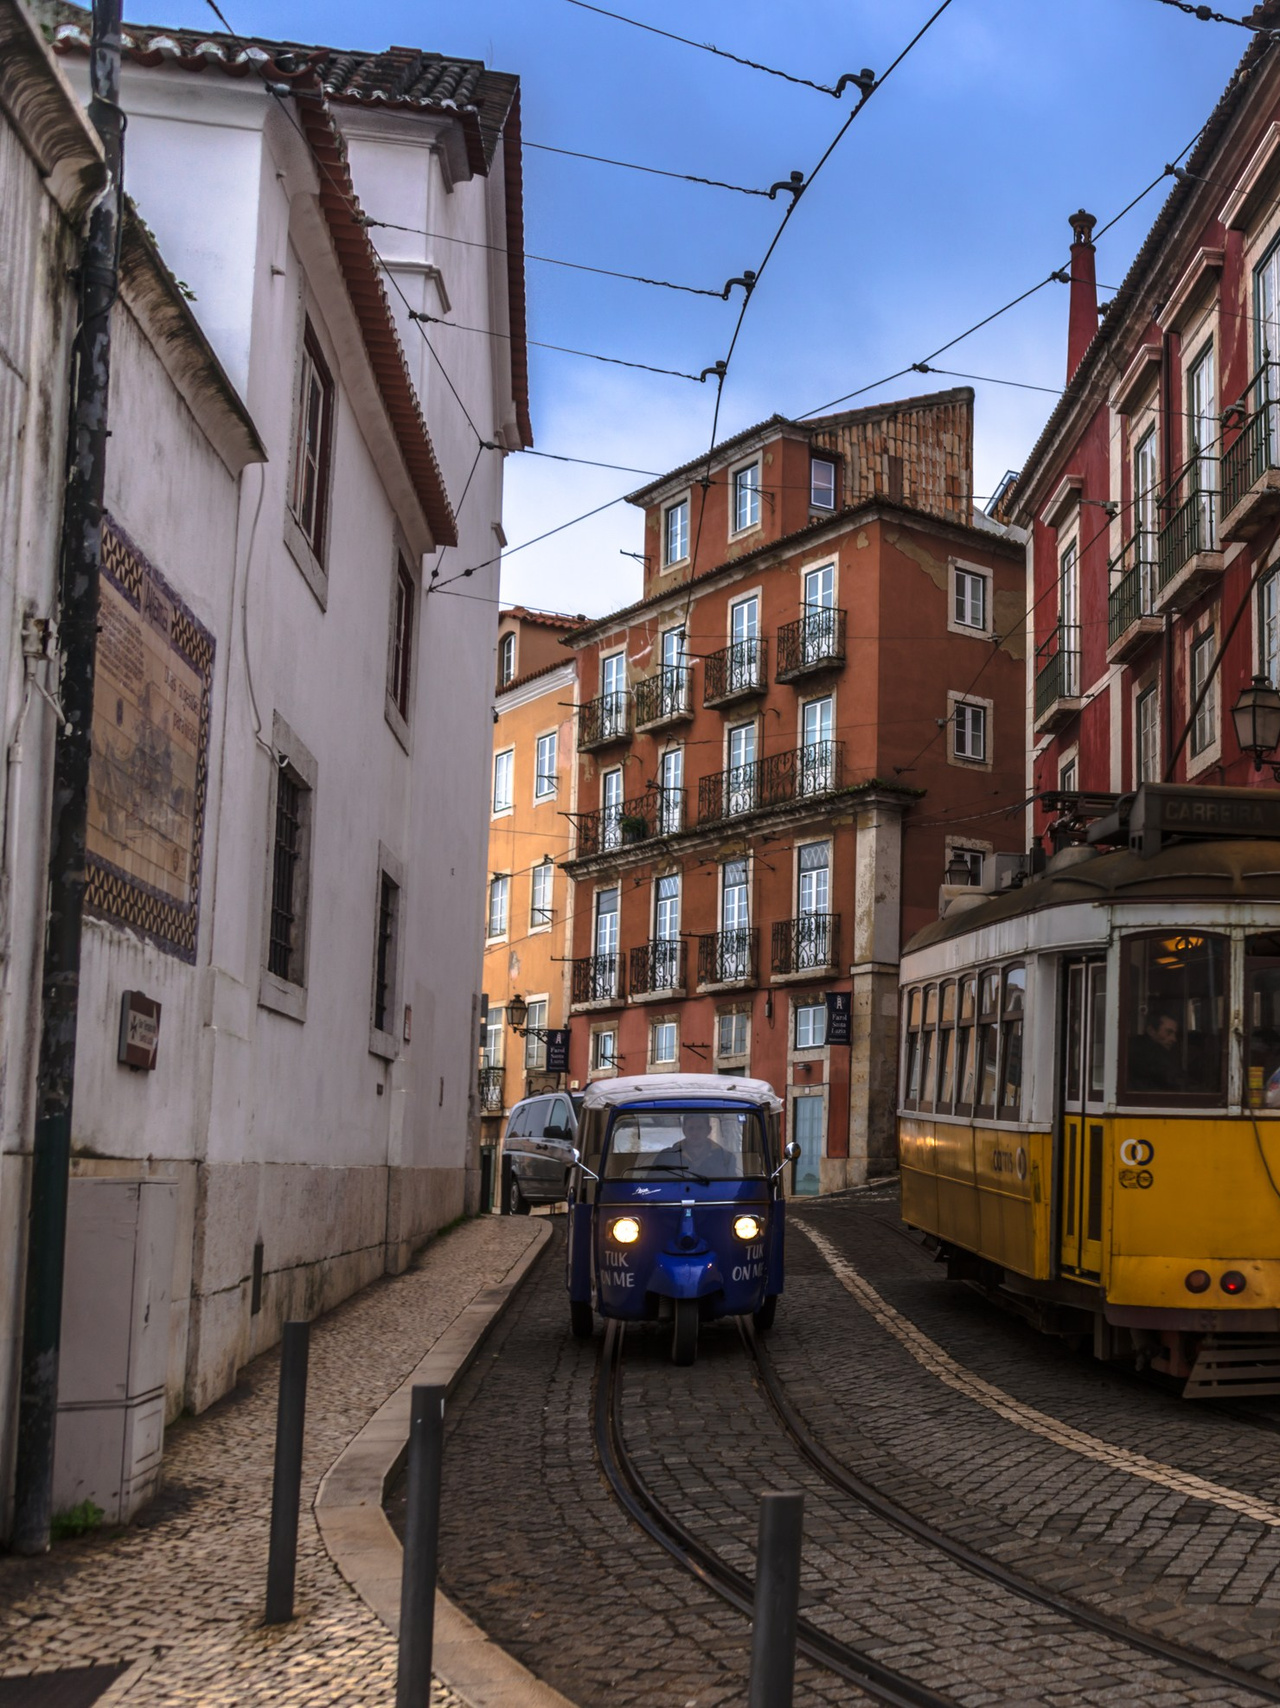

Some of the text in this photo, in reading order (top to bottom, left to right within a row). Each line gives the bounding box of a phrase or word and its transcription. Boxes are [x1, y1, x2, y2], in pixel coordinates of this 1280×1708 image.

[1165, 801, 1264, 824] CARREIRA
[605, 1250, 629, 1267] TUK
[745, 1244, 764, 1261] TUK
[613, 1272, 635, 1287] ME
[732, 1264, 751, 1281] ON
